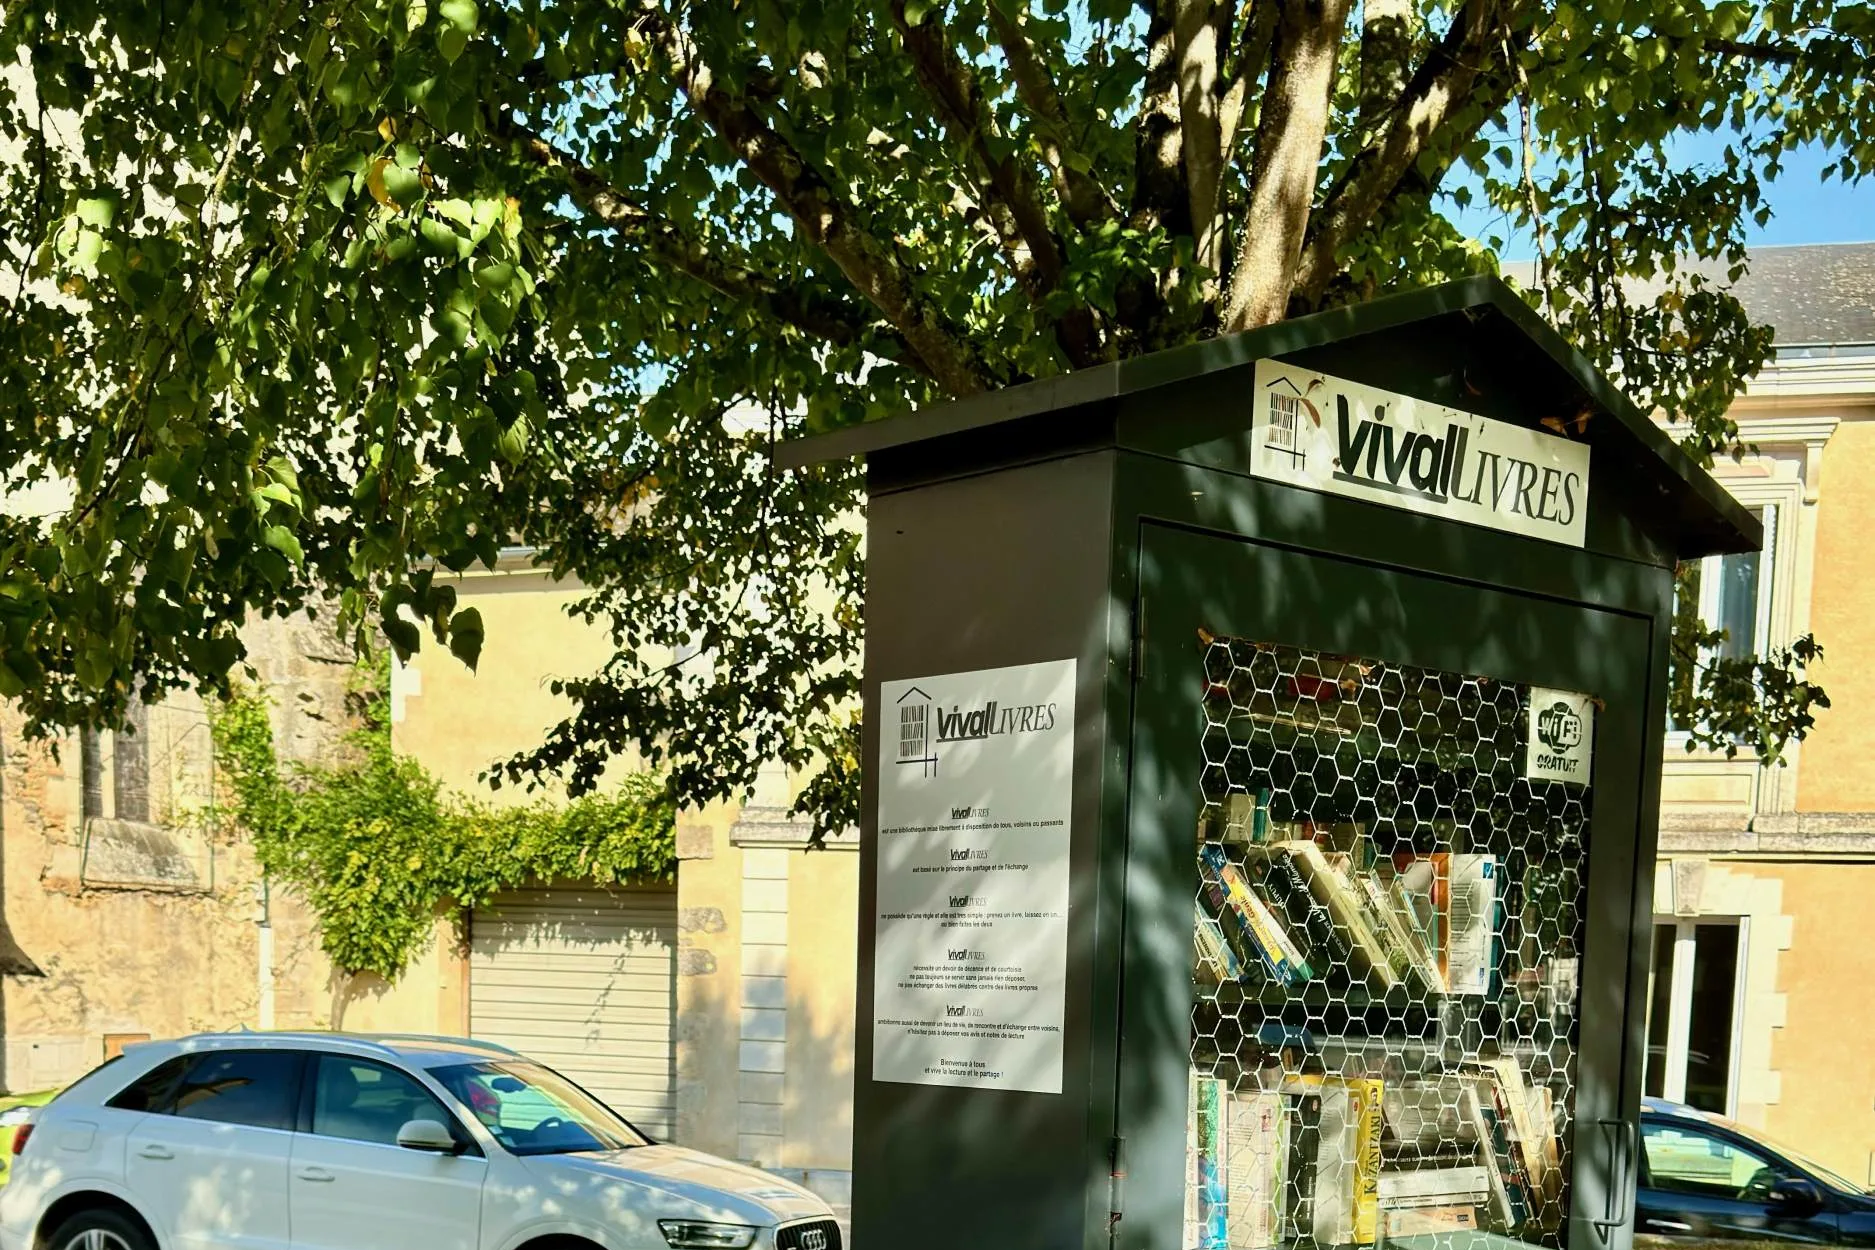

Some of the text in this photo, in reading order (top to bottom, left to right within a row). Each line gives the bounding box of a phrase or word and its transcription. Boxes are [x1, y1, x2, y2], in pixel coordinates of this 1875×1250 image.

[1537, 754, 1579, 772] GRATUIT
[966, 822, 992, 830] disposition
[1013, 820, 1031, 828] voisins
[1040, 819, 1063, 828] passants
[941, 1058, 968, 1067] Bienvenue
[974, 1060, 985, 1068] tous
[949, 1068, 967, 1076] lecture
[980, 1070, 1000, 1080] partage
